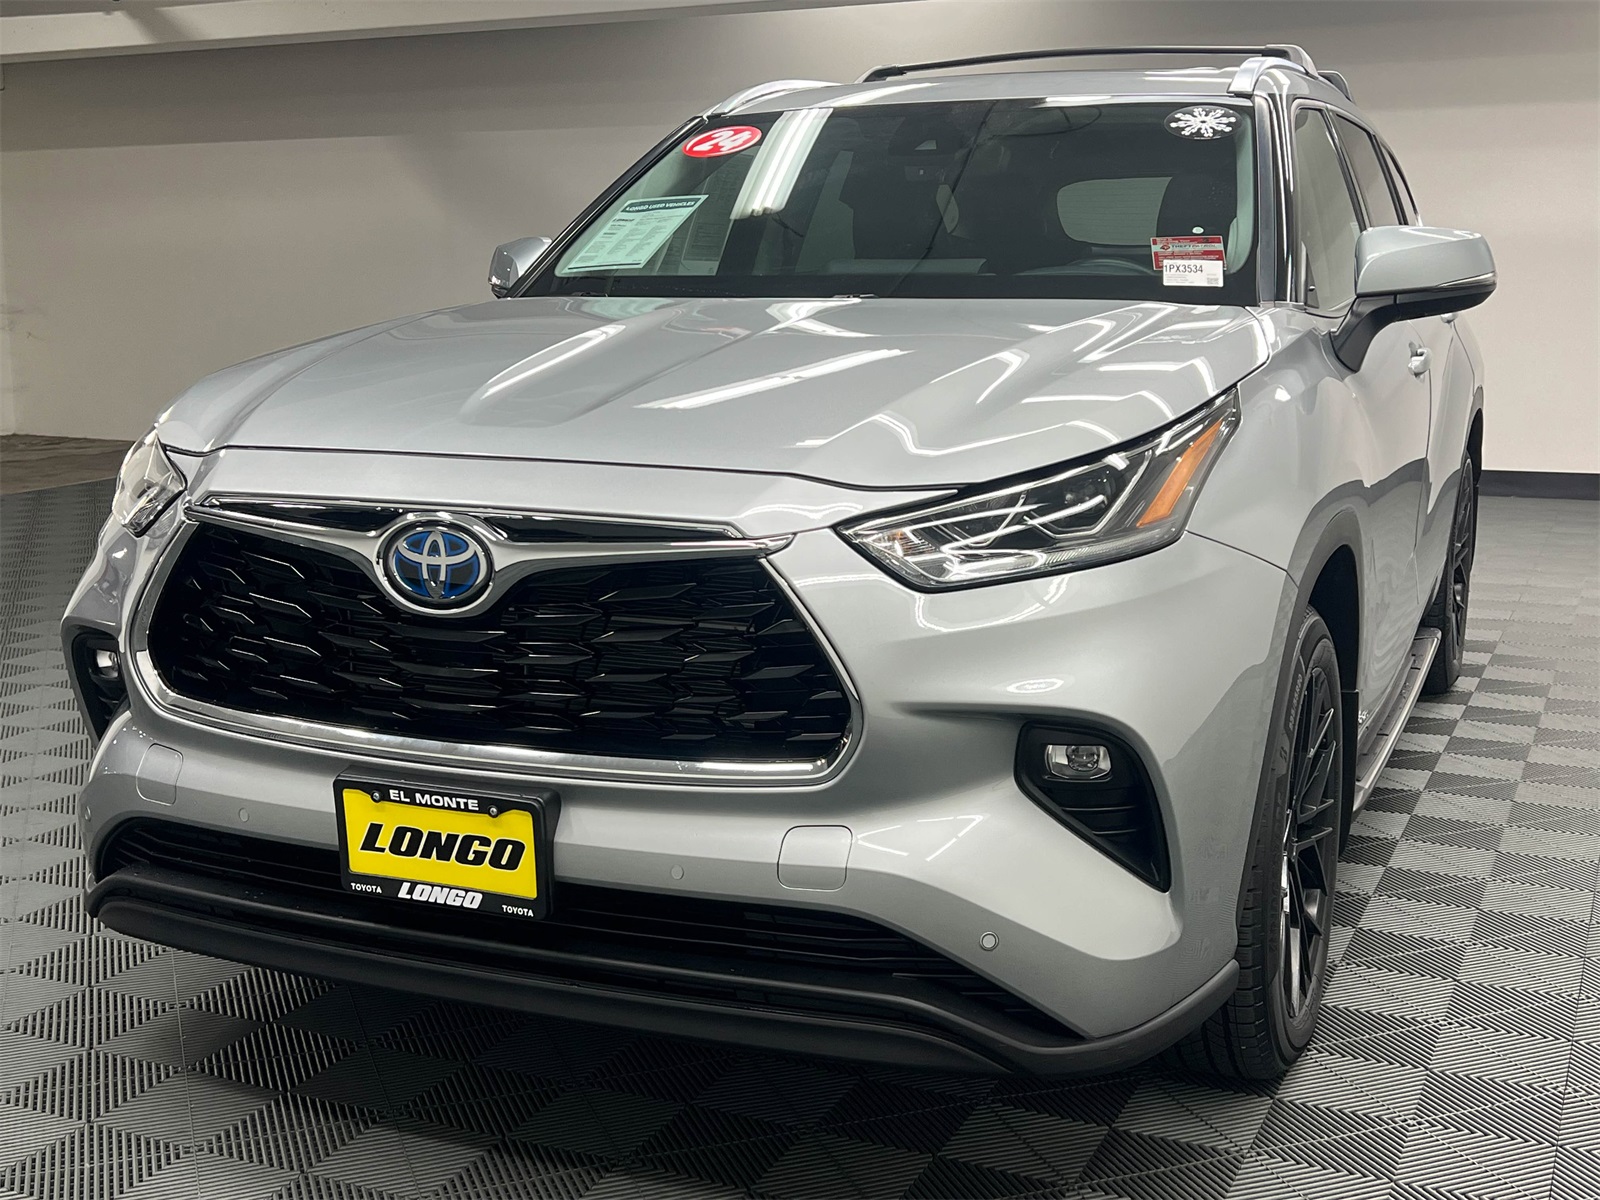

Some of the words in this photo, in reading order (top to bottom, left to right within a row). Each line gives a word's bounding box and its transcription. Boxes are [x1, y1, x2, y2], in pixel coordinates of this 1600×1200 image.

[692, 130, 752, 151] 24
[1164, 264, 1203, 273] 1PX3534
[389, 789, 411, 802] EL
[415, 793, 479, 811] MONTE
[359, 822, 526, 871] LONGO
[350, 882, 382, 894] TOYOTA
[397, 881, 483, 909] LONGO
[502, 904, 534, 917] TOYOTA
